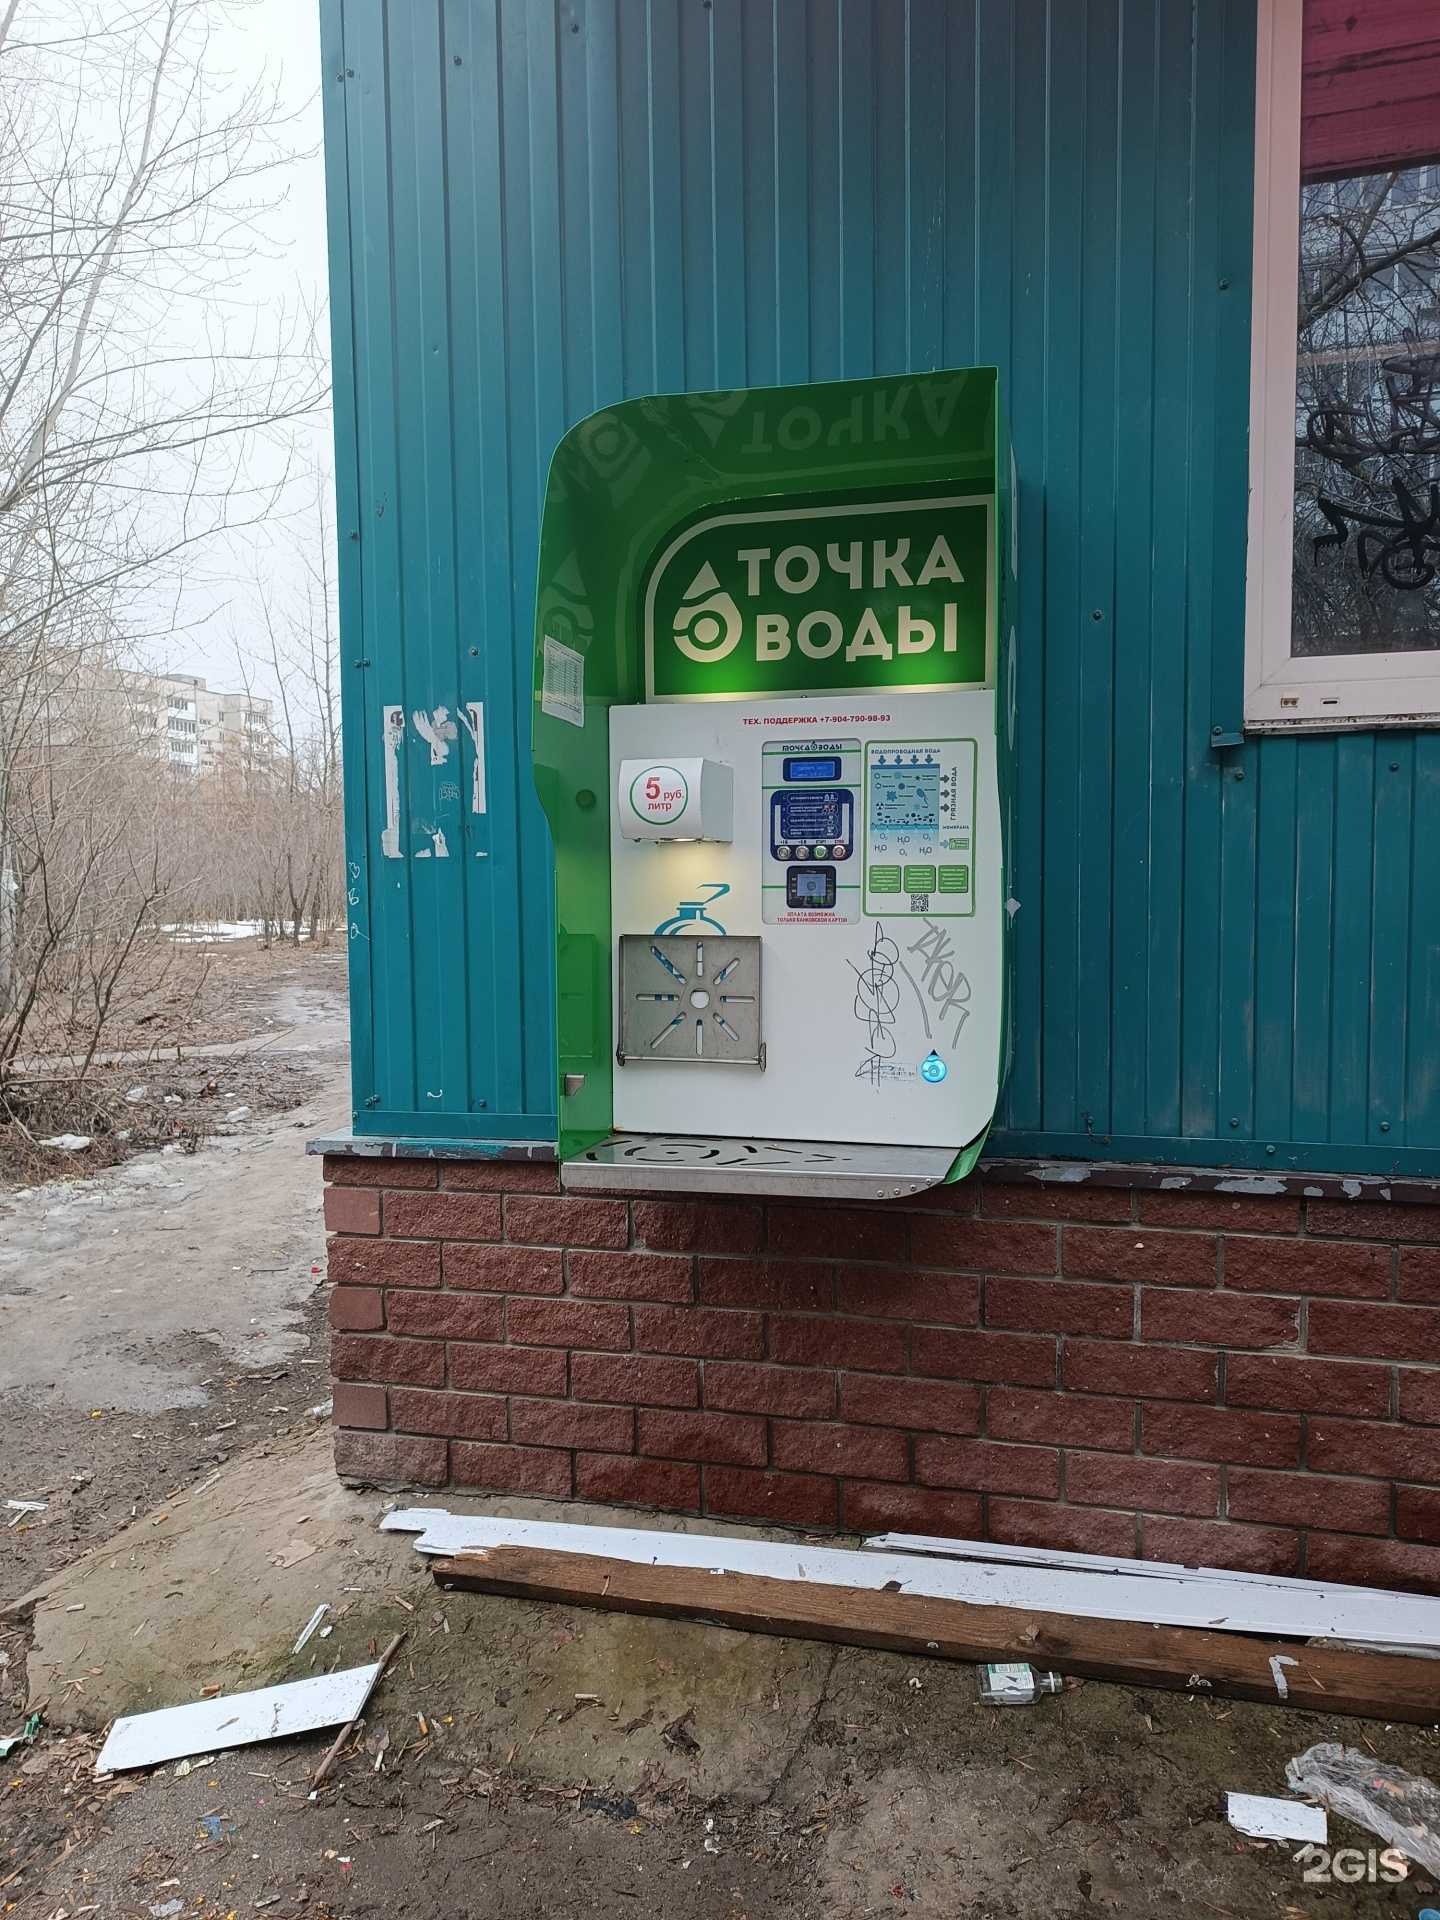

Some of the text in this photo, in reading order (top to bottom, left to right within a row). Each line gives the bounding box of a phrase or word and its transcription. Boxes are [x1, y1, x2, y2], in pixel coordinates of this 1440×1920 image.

[737, 534, 965, 597] ТОЧКА
[755, 602, 958, 663] ВОДЫ
[743, 717, 761, 725] ТЕХ.
[763, 715, 818, 725] ПОДДЕРЖКА
[950, 766, 958, 787] ВОДА
[645, 776, 685, 801] 5 руб.
[647, 802, 672, 812] литр
